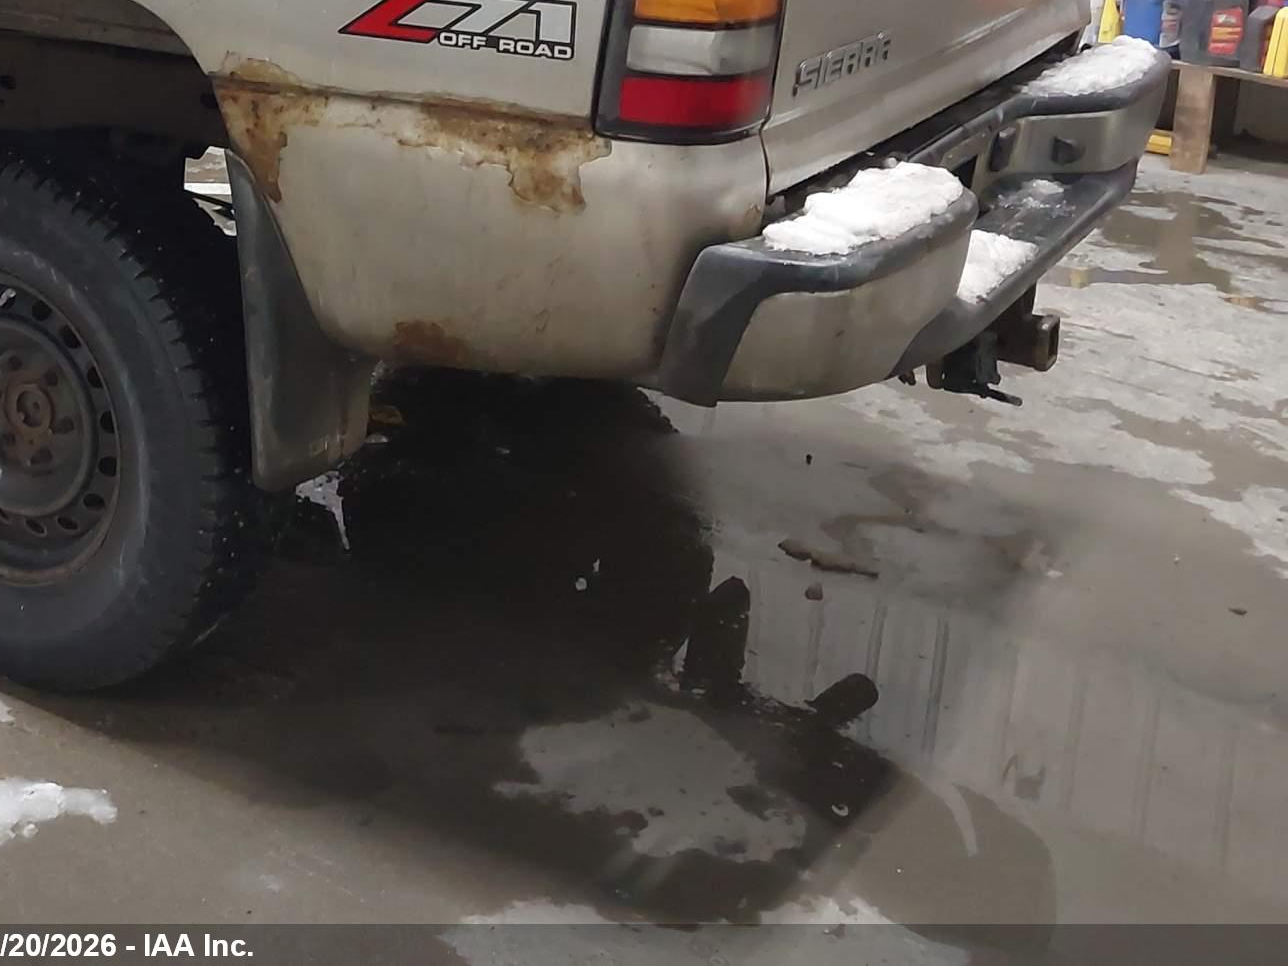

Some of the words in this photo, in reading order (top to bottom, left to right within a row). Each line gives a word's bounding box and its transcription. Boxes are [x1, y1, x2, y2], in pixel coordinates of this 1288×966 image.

[439, 32, 487, 48] OFF
[498, 39, 572, 59] ROAD
[795, 31, 891, 91] SIERRA
